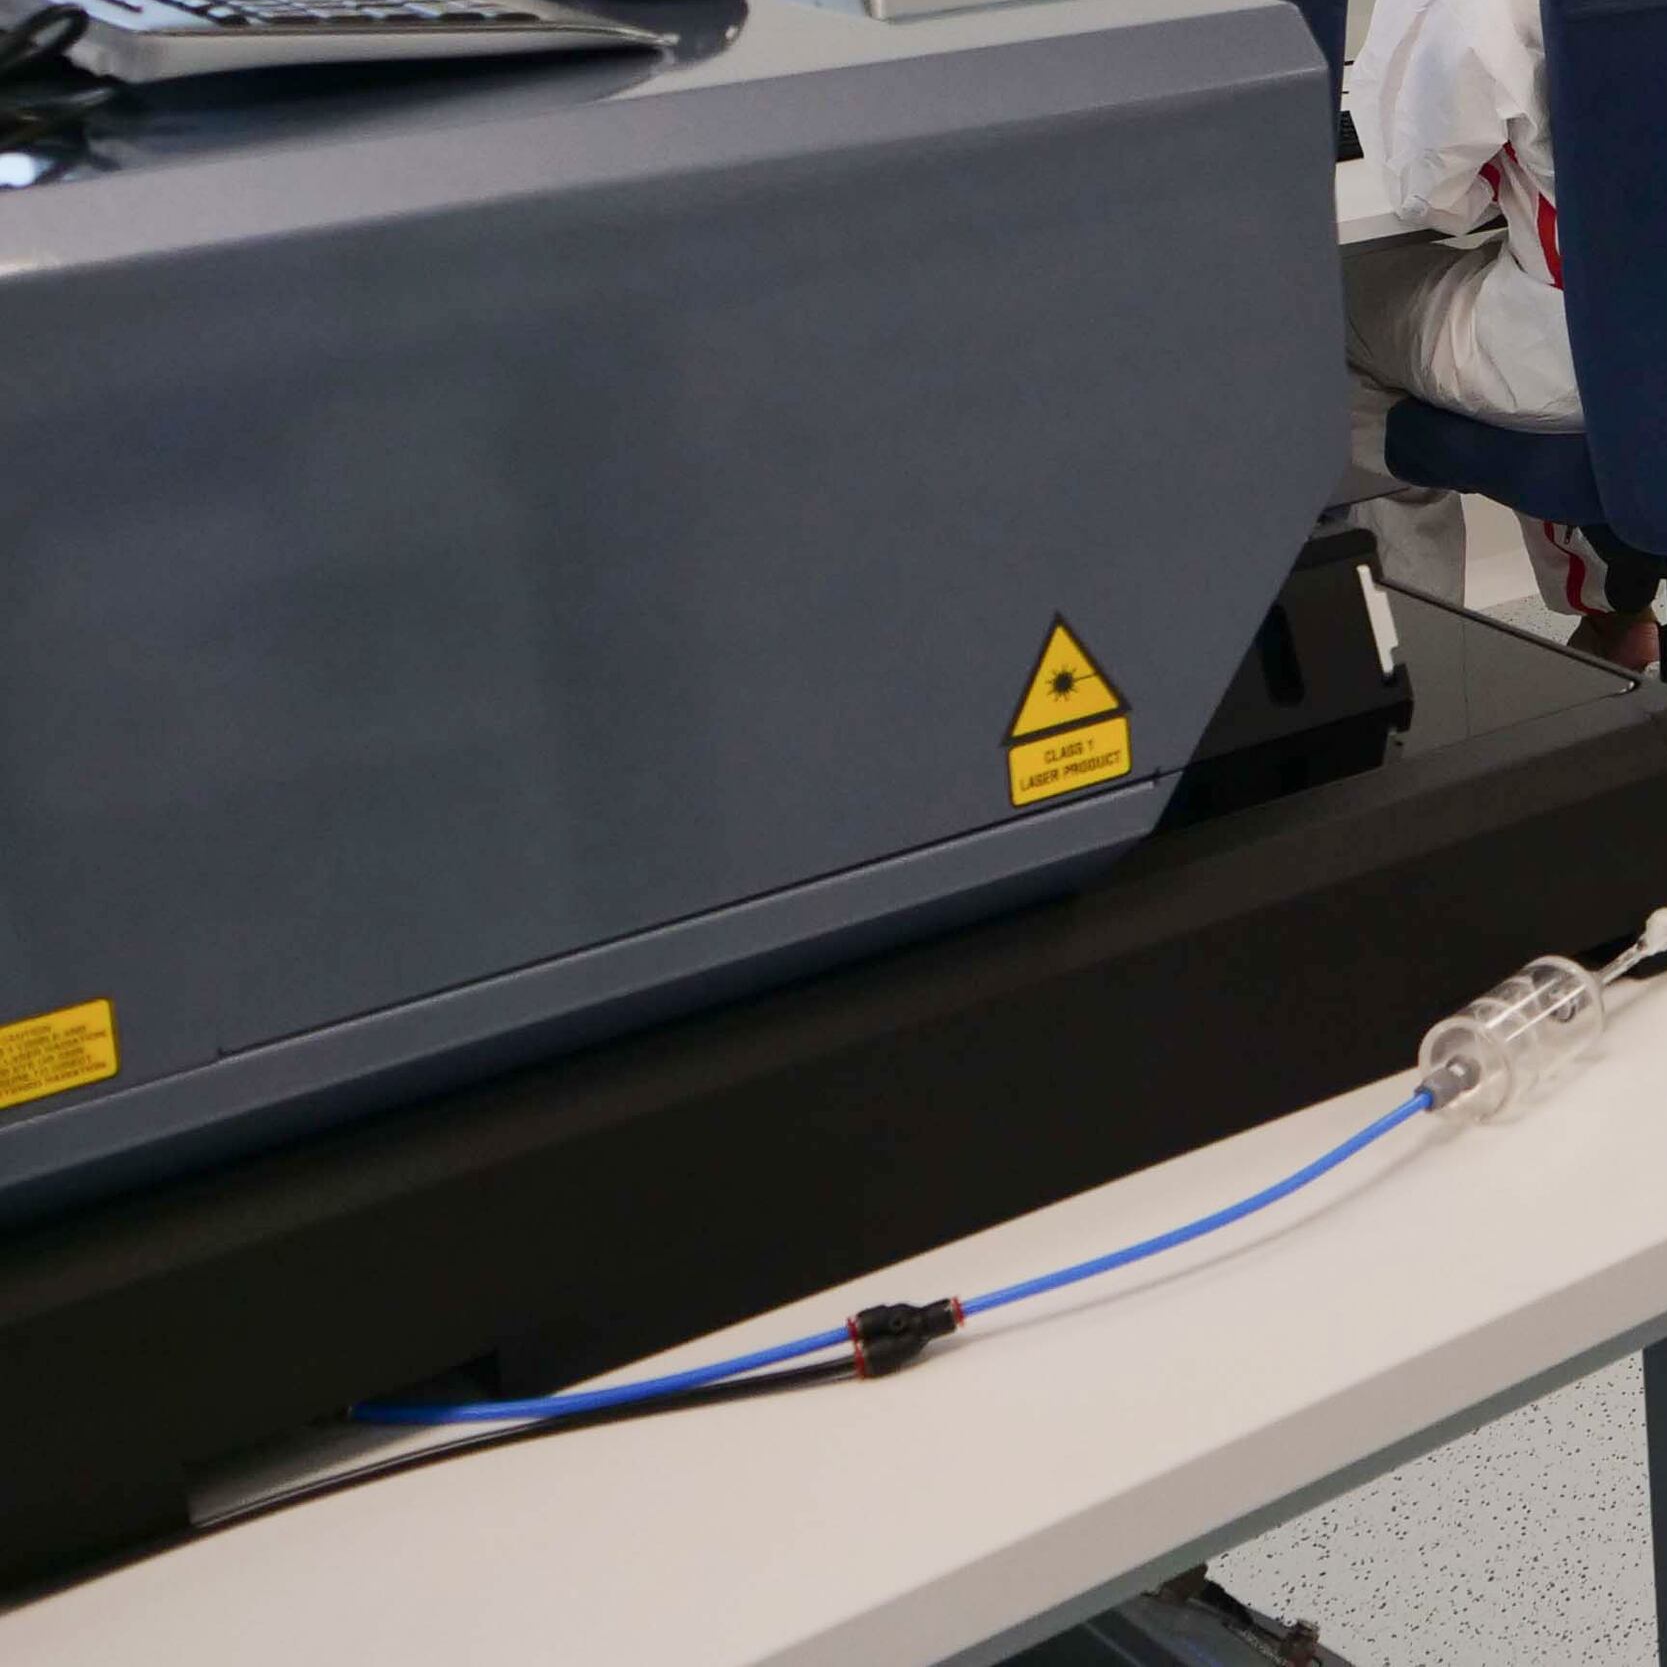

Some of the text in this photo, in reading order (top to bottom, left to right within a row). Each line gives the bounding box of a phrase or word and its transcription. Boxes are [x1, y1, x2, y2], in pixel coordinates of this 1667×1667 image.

[1043, 741, 1083, 764] CLASS
[1019, 749, 1122, 792] LASER PRODUCT
